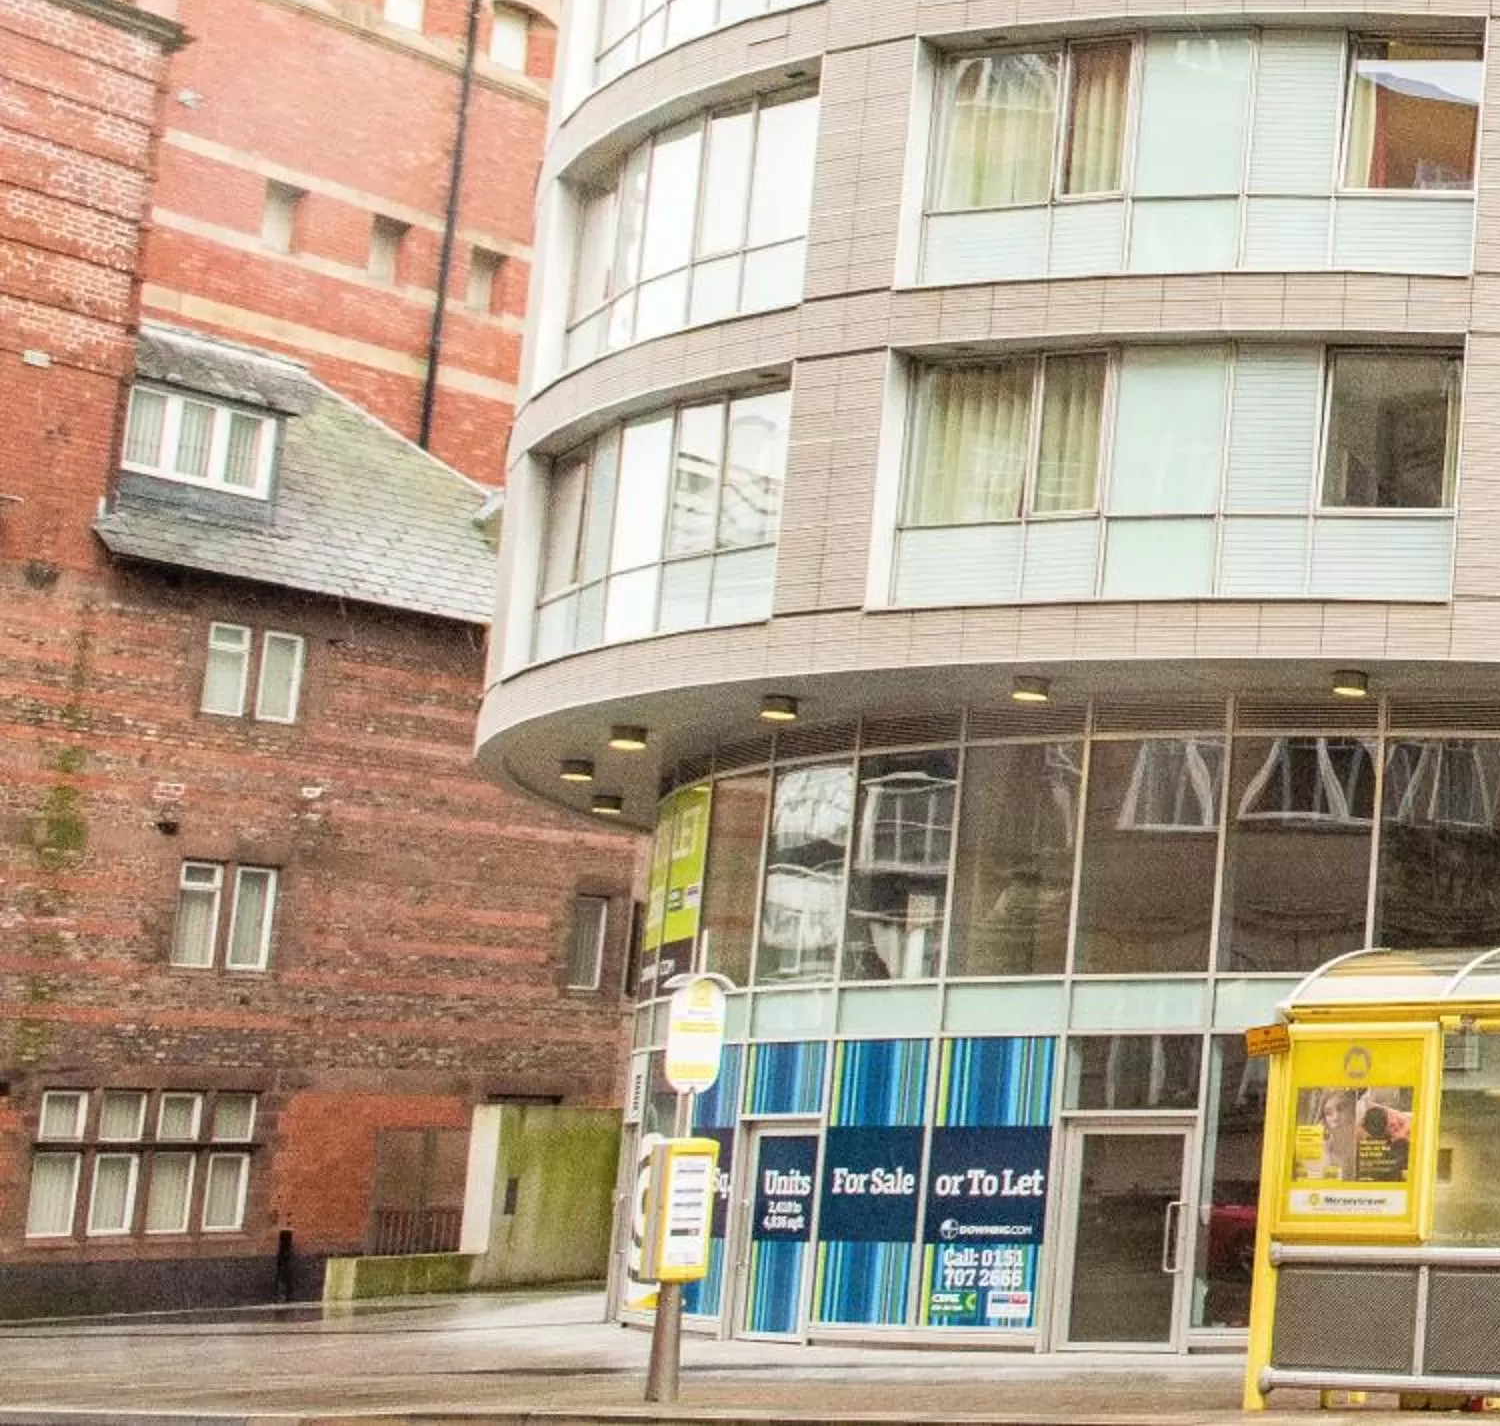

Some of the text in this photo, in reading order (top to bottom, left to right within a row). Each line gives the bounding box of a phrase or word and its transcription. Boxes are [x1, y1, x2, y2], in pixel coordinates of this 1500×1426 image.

[763, 1168, 812, 1196] Units
[831, 1167, 869, 1195] For
[870, 1166, 915, 1195] Sale
[935, 1174, 965, 1196] or
[966, 1169, 999, 1196] To
[1001, 1168, 1045, 1196] Let
[943, 1248, 1025, 1267] Call: 0151
[944, 1269, 977, 1287] 707
